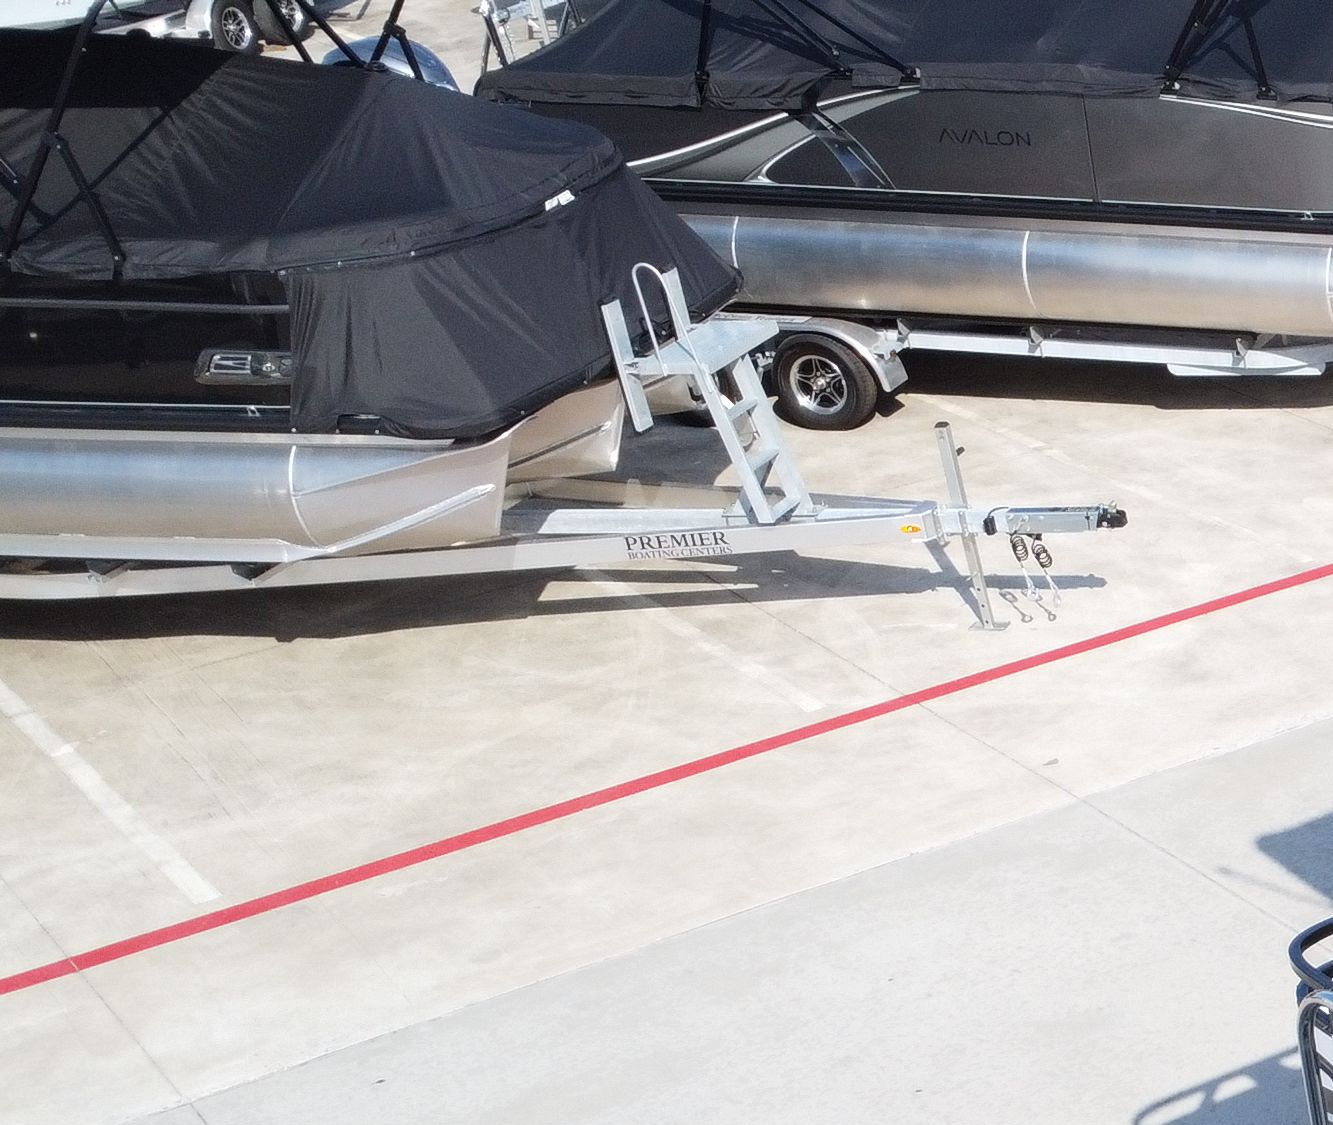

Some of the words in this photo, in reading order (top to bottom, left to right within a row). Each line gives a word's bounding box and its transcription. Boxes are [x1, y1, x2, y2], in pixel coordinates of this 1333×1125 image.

[939, 128, 1032, 146] AVALON
[623, 530, 730, 551] PREMIER
[627, 548, 680, 561] BOATING
[681, 545, 734, 558] CENTERS
